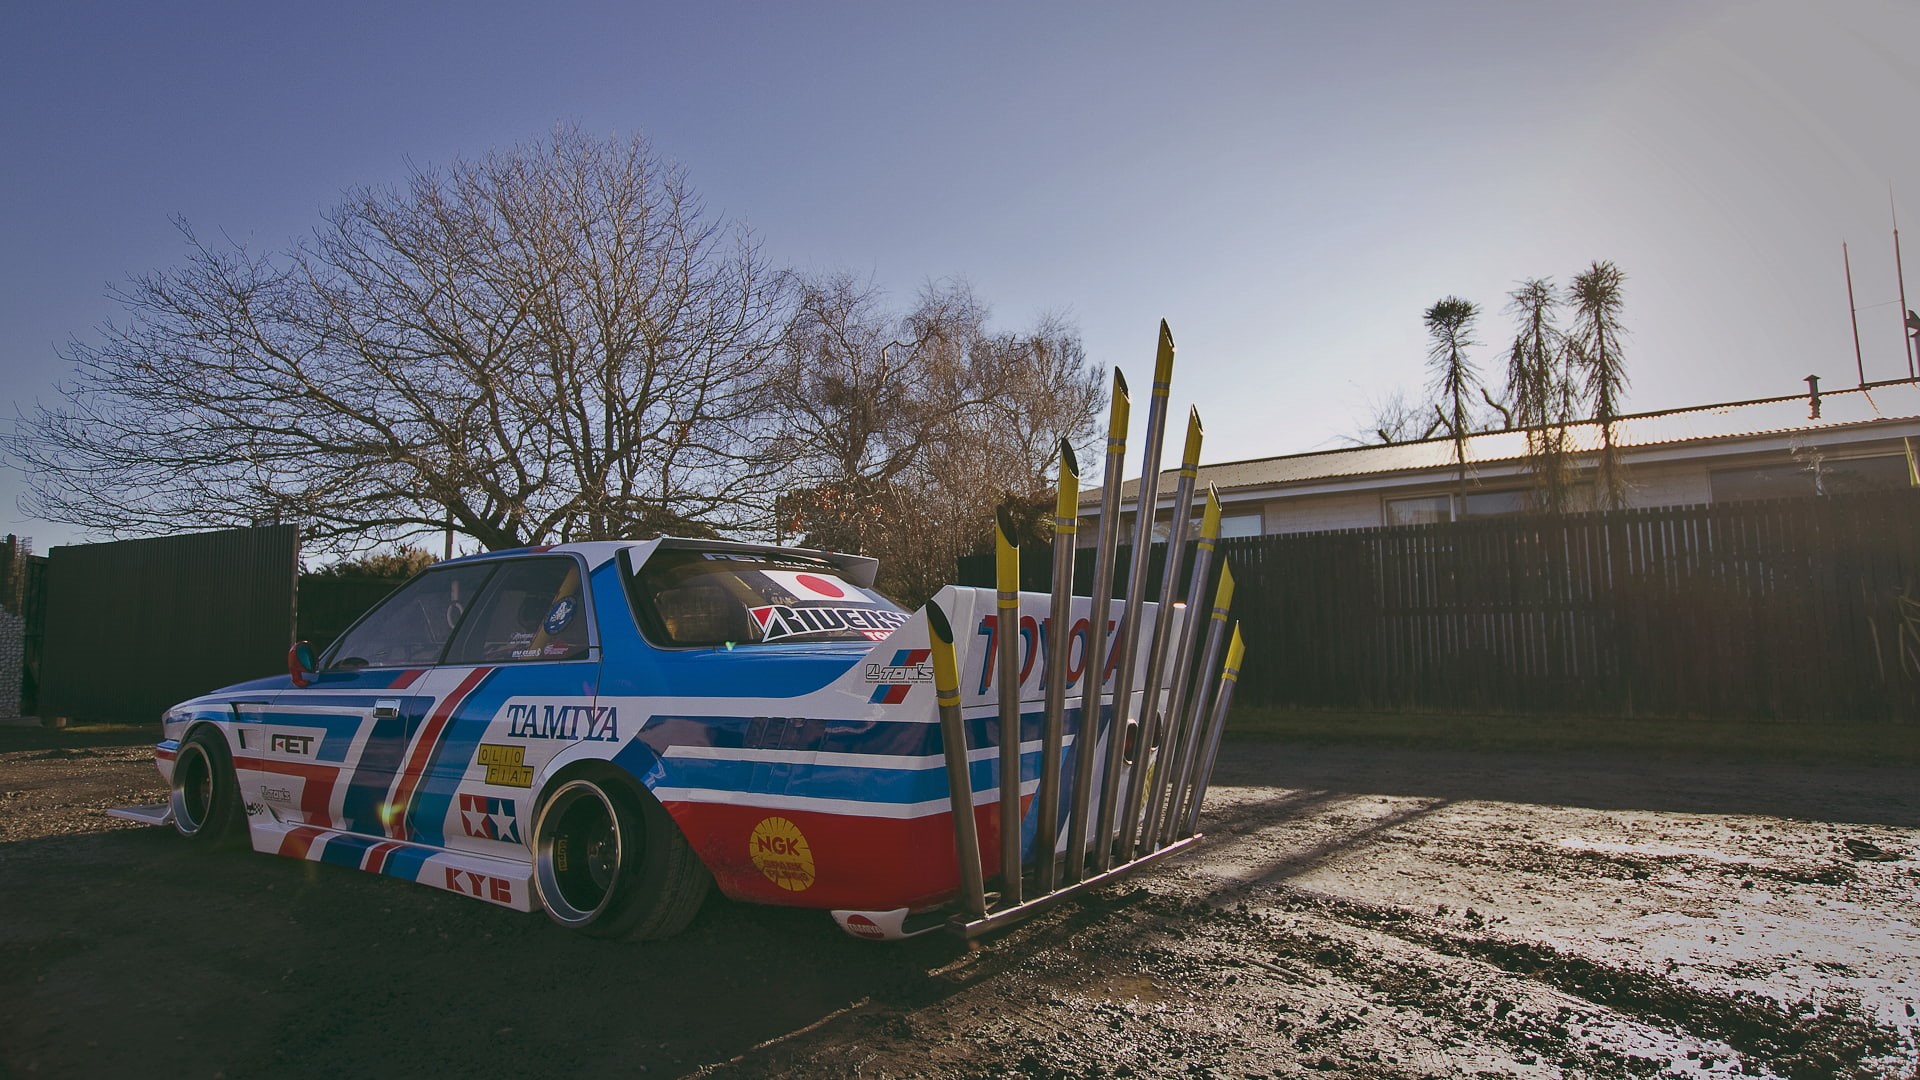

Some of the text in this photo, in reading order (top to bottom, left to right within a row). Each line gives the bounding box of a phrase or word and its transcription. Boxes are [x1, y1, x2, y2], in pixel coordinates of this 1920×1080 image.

[506, 704, 620, 743] TAMIYA
[271, 734, 315, 755] FET
[480, 749, 521, 762] OLIO
[489, 768, 532, 782] FIAT
[756, 836, 801, 857] NGK
[445, 867, 512, 904] KYB
